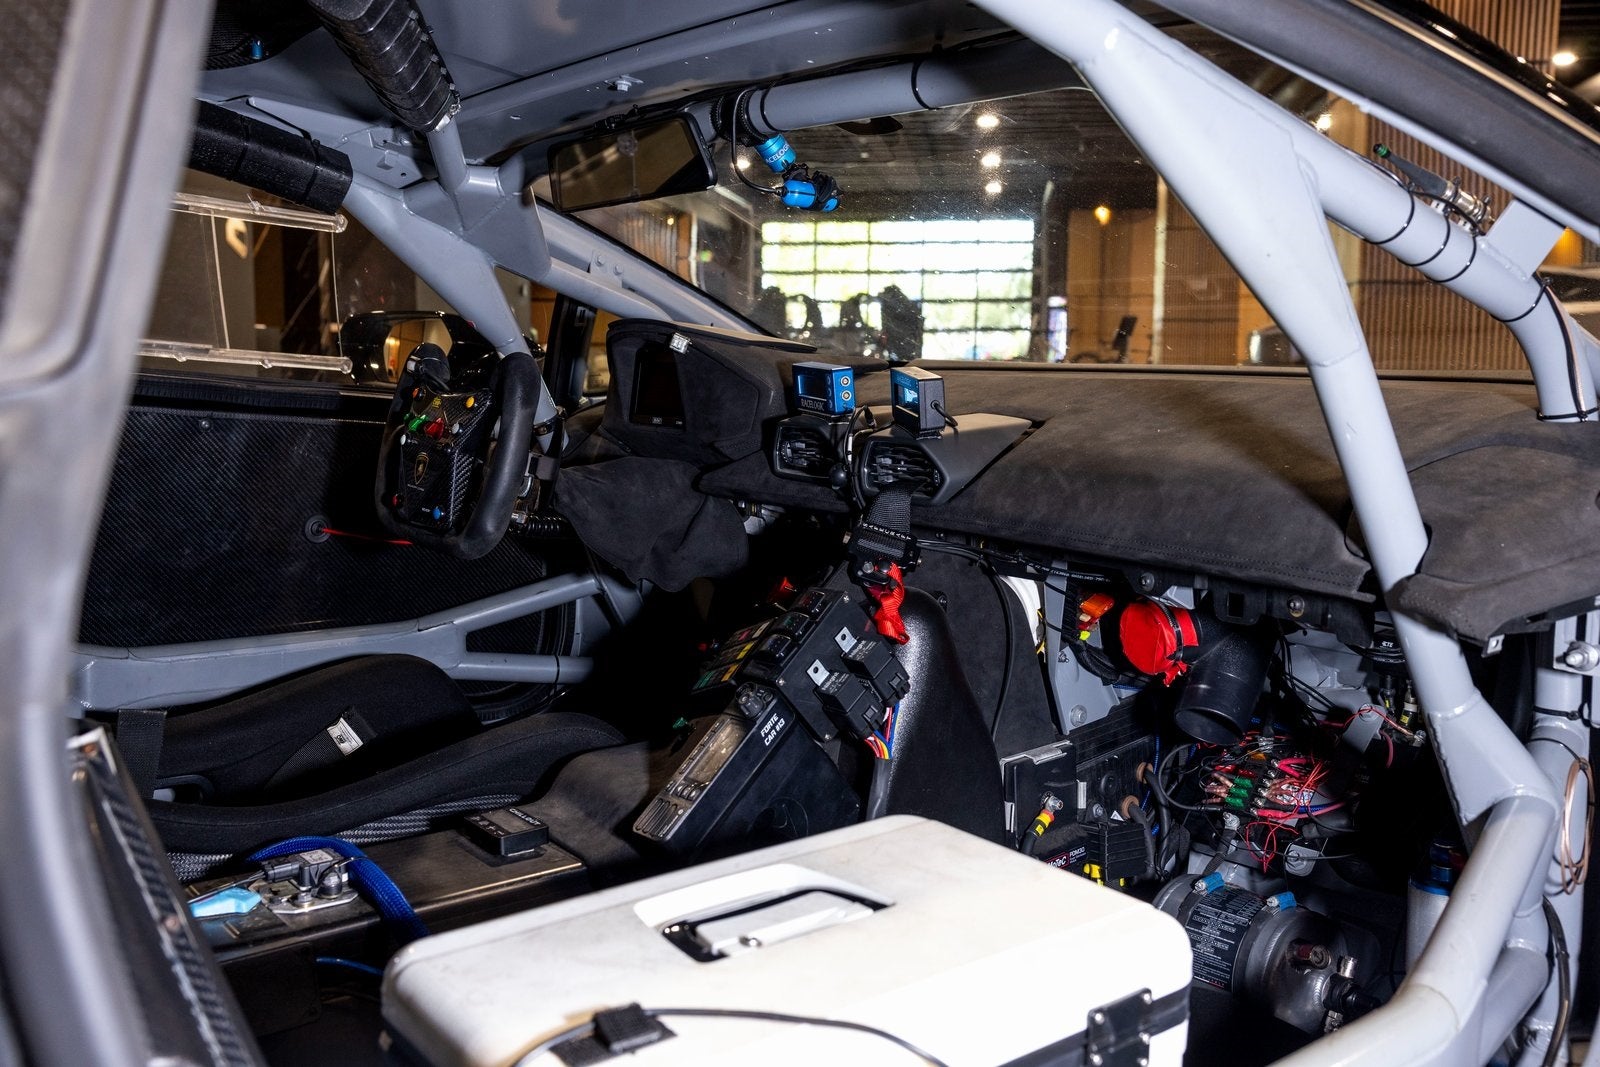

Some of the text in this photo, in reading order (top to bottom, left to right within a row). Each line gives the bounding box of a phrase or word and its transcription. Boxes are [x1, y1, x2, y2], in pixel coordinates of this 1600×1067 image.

[760, 712, 778, 737] FORTE
[764, 717, 785, 746] CAR #13
